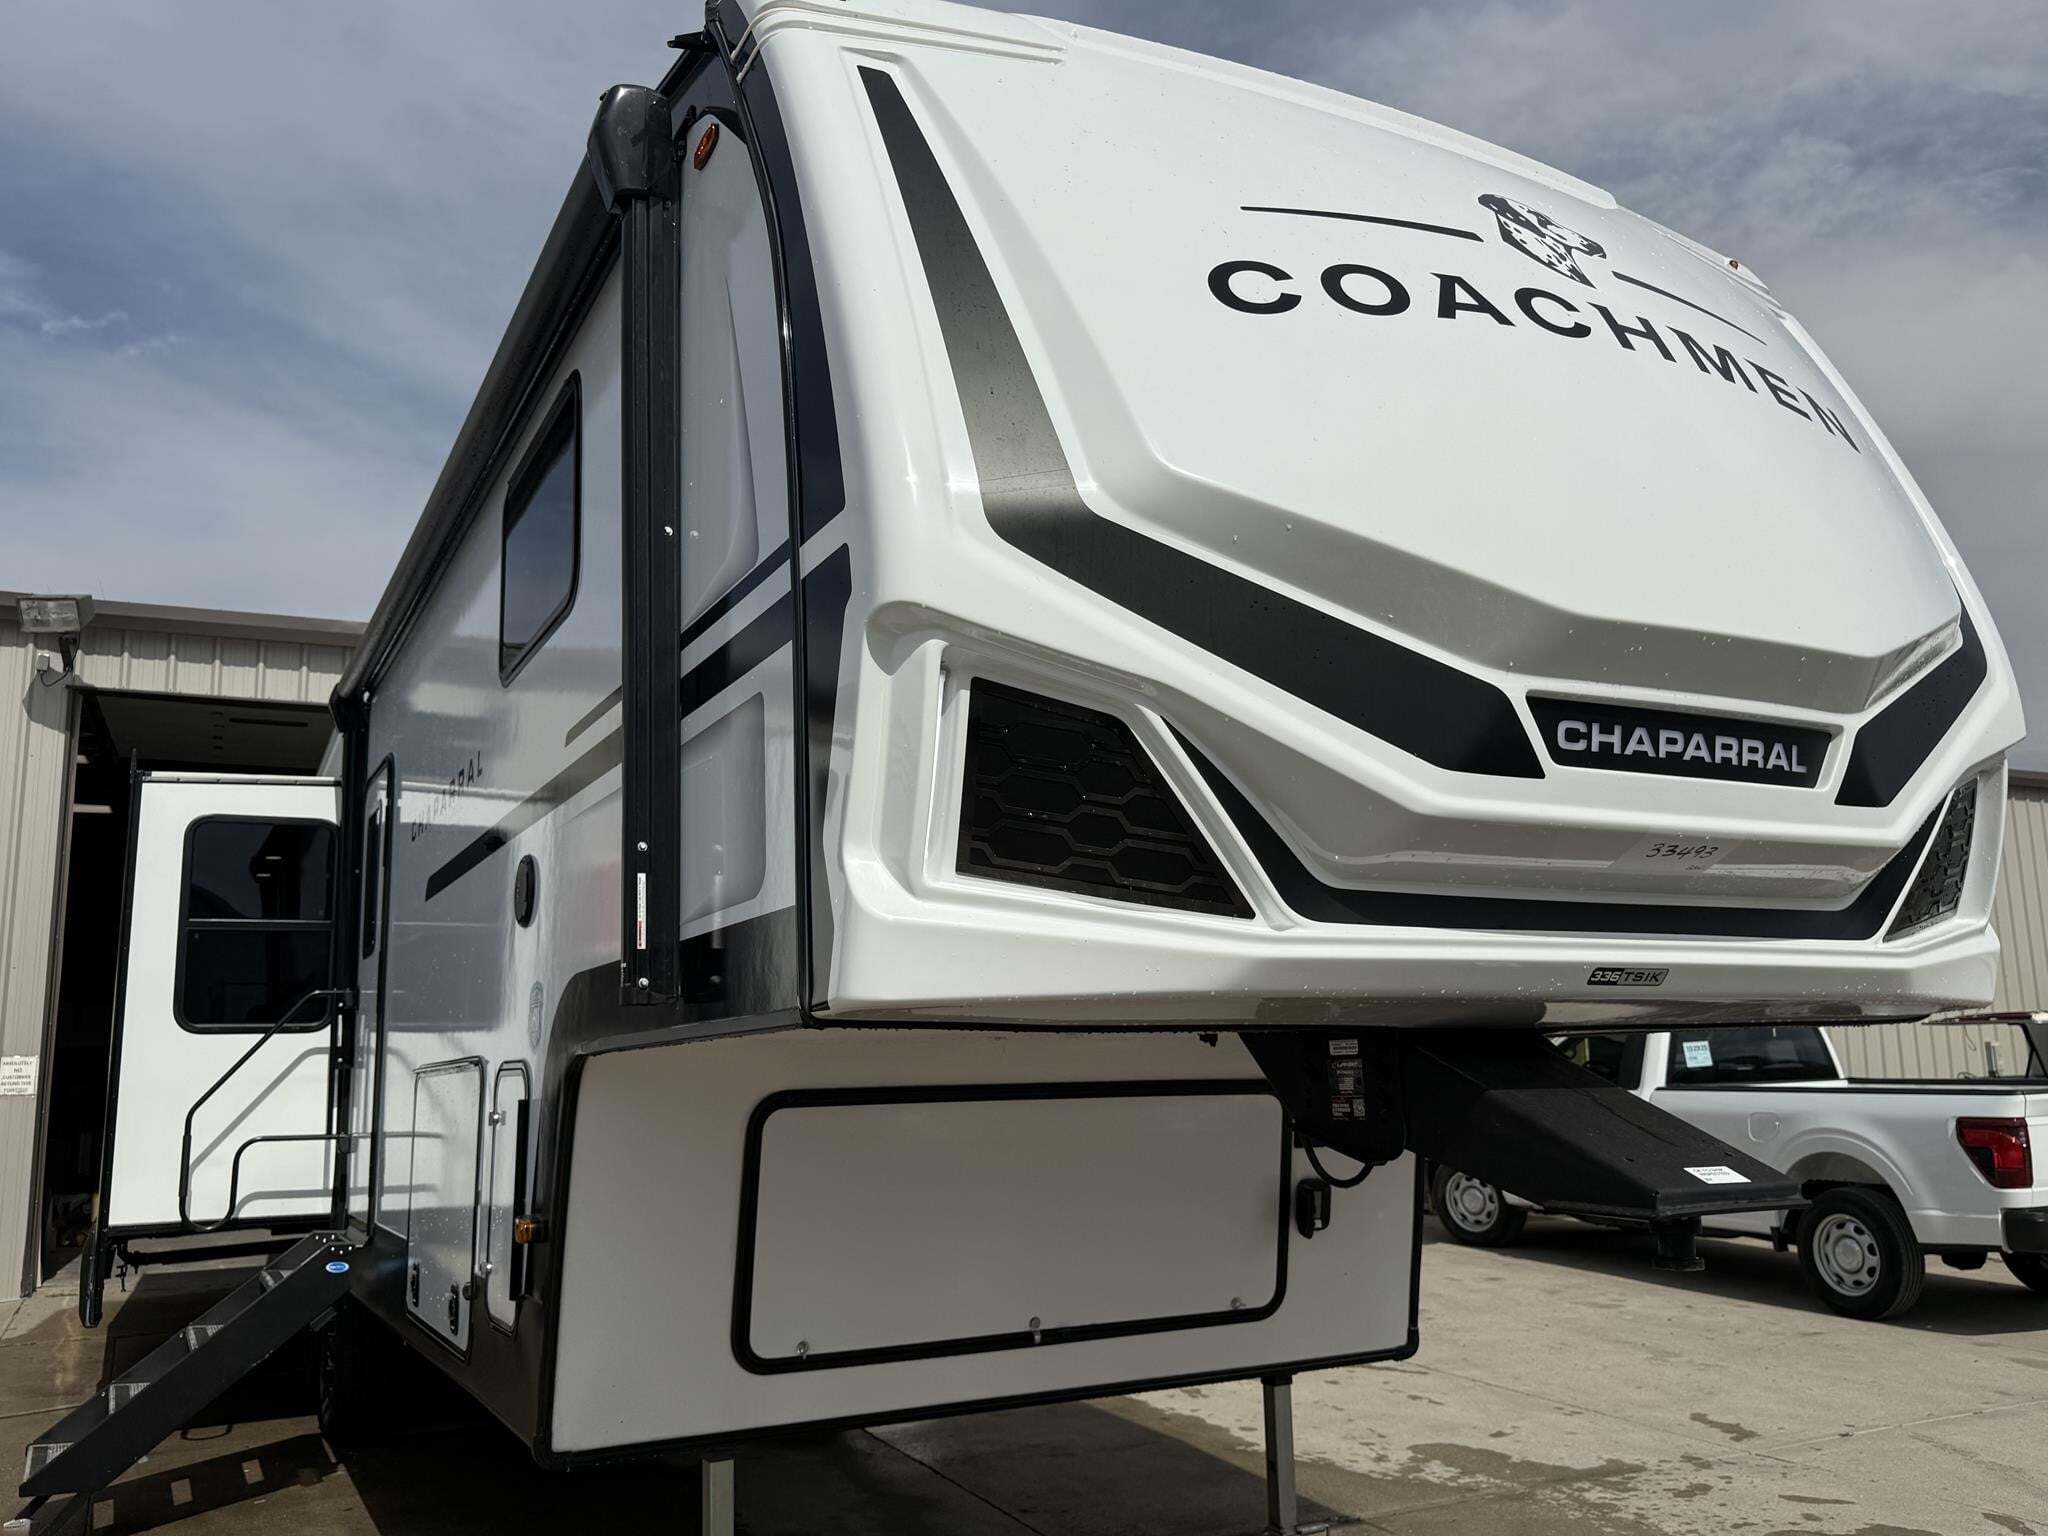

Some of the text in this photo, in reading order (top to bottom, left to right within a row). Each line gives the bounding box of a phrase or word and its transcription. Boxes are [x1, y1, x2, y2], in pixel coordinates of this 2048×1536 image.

[1207, 260, 1861, 454] COACHMEN
[1556, 719, 1807, 774] CHAPARRAL
[1645, 843, 1719, 860] 33493
